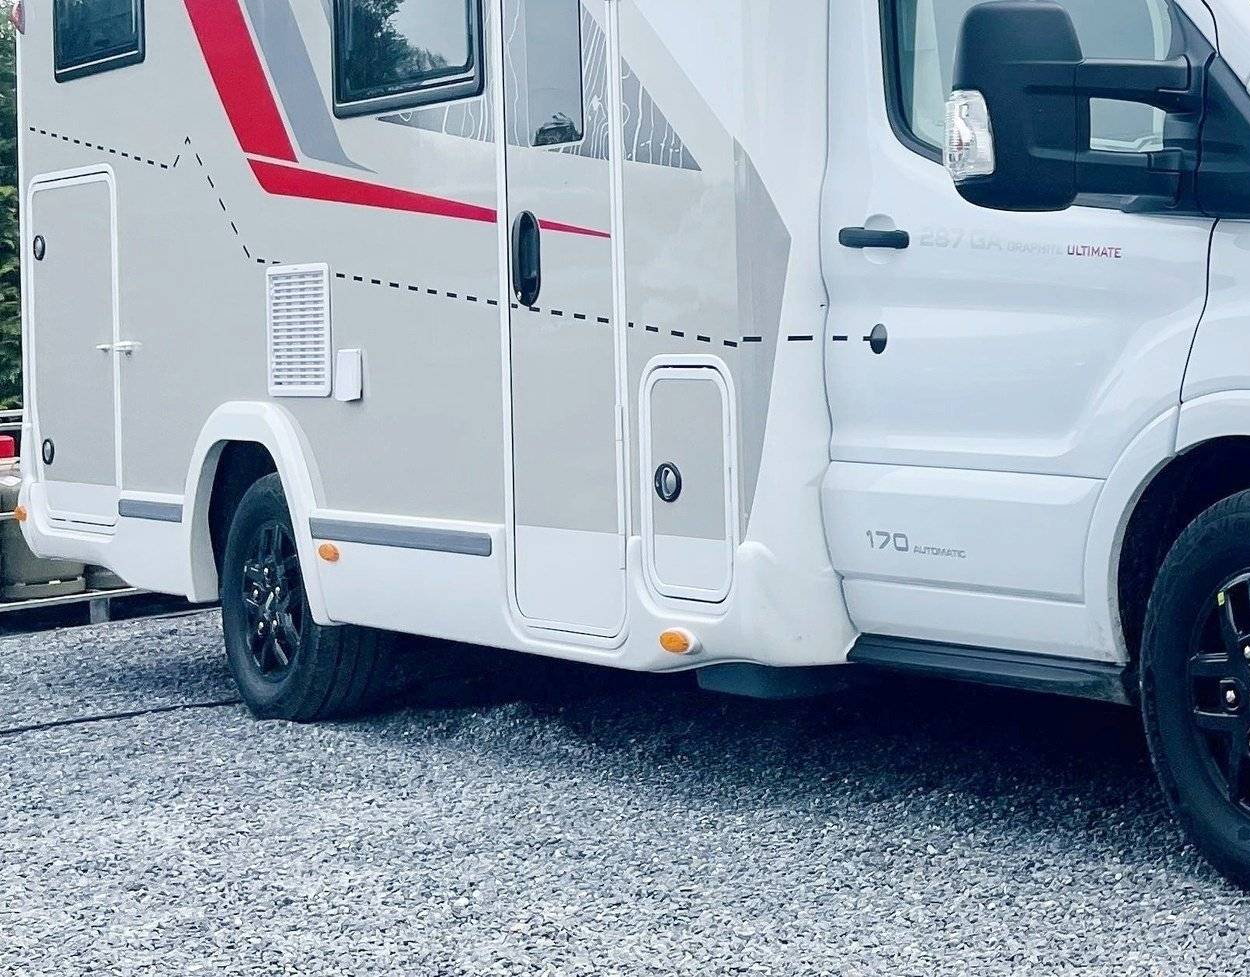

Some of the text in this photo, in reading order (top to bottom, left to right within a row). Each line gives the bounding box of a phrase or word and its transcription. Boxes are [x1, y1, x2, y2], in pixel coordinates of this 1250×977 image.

[919, 228, 964, 248] 287
[970, 231, 1002, 250] GA
[1067, 244, 1121, 259] ULTIMATE
[866, 529, 967, 559] 170 AUTOMATIC
